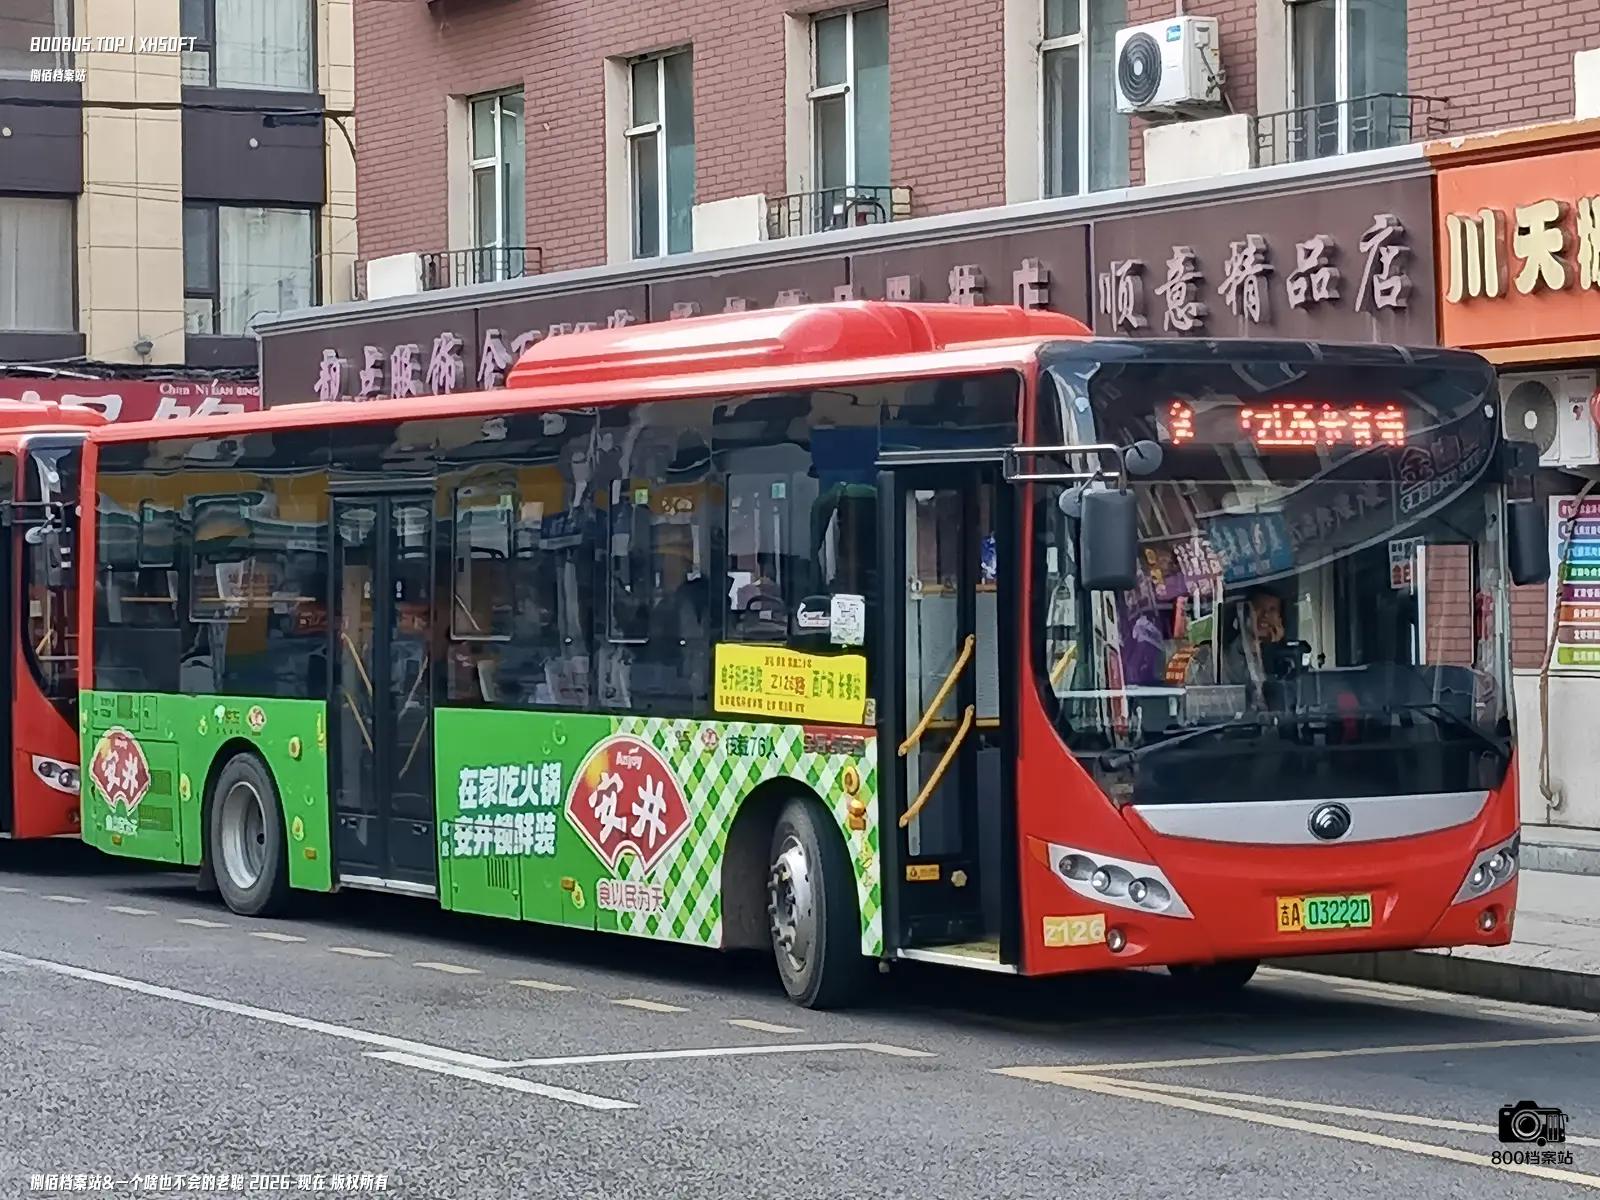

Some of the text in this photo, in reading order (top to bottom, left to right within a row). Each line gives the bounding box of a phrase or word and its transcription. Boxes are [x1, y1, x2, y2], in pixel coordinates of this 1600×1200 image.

[1099, 213, 1411, 333] 顺意精品店
[458, 762, 562, 810] 在家吃火锅
[588, 772, 668, 849] 安井
[599, 880, 664, 913] 食以民为天
